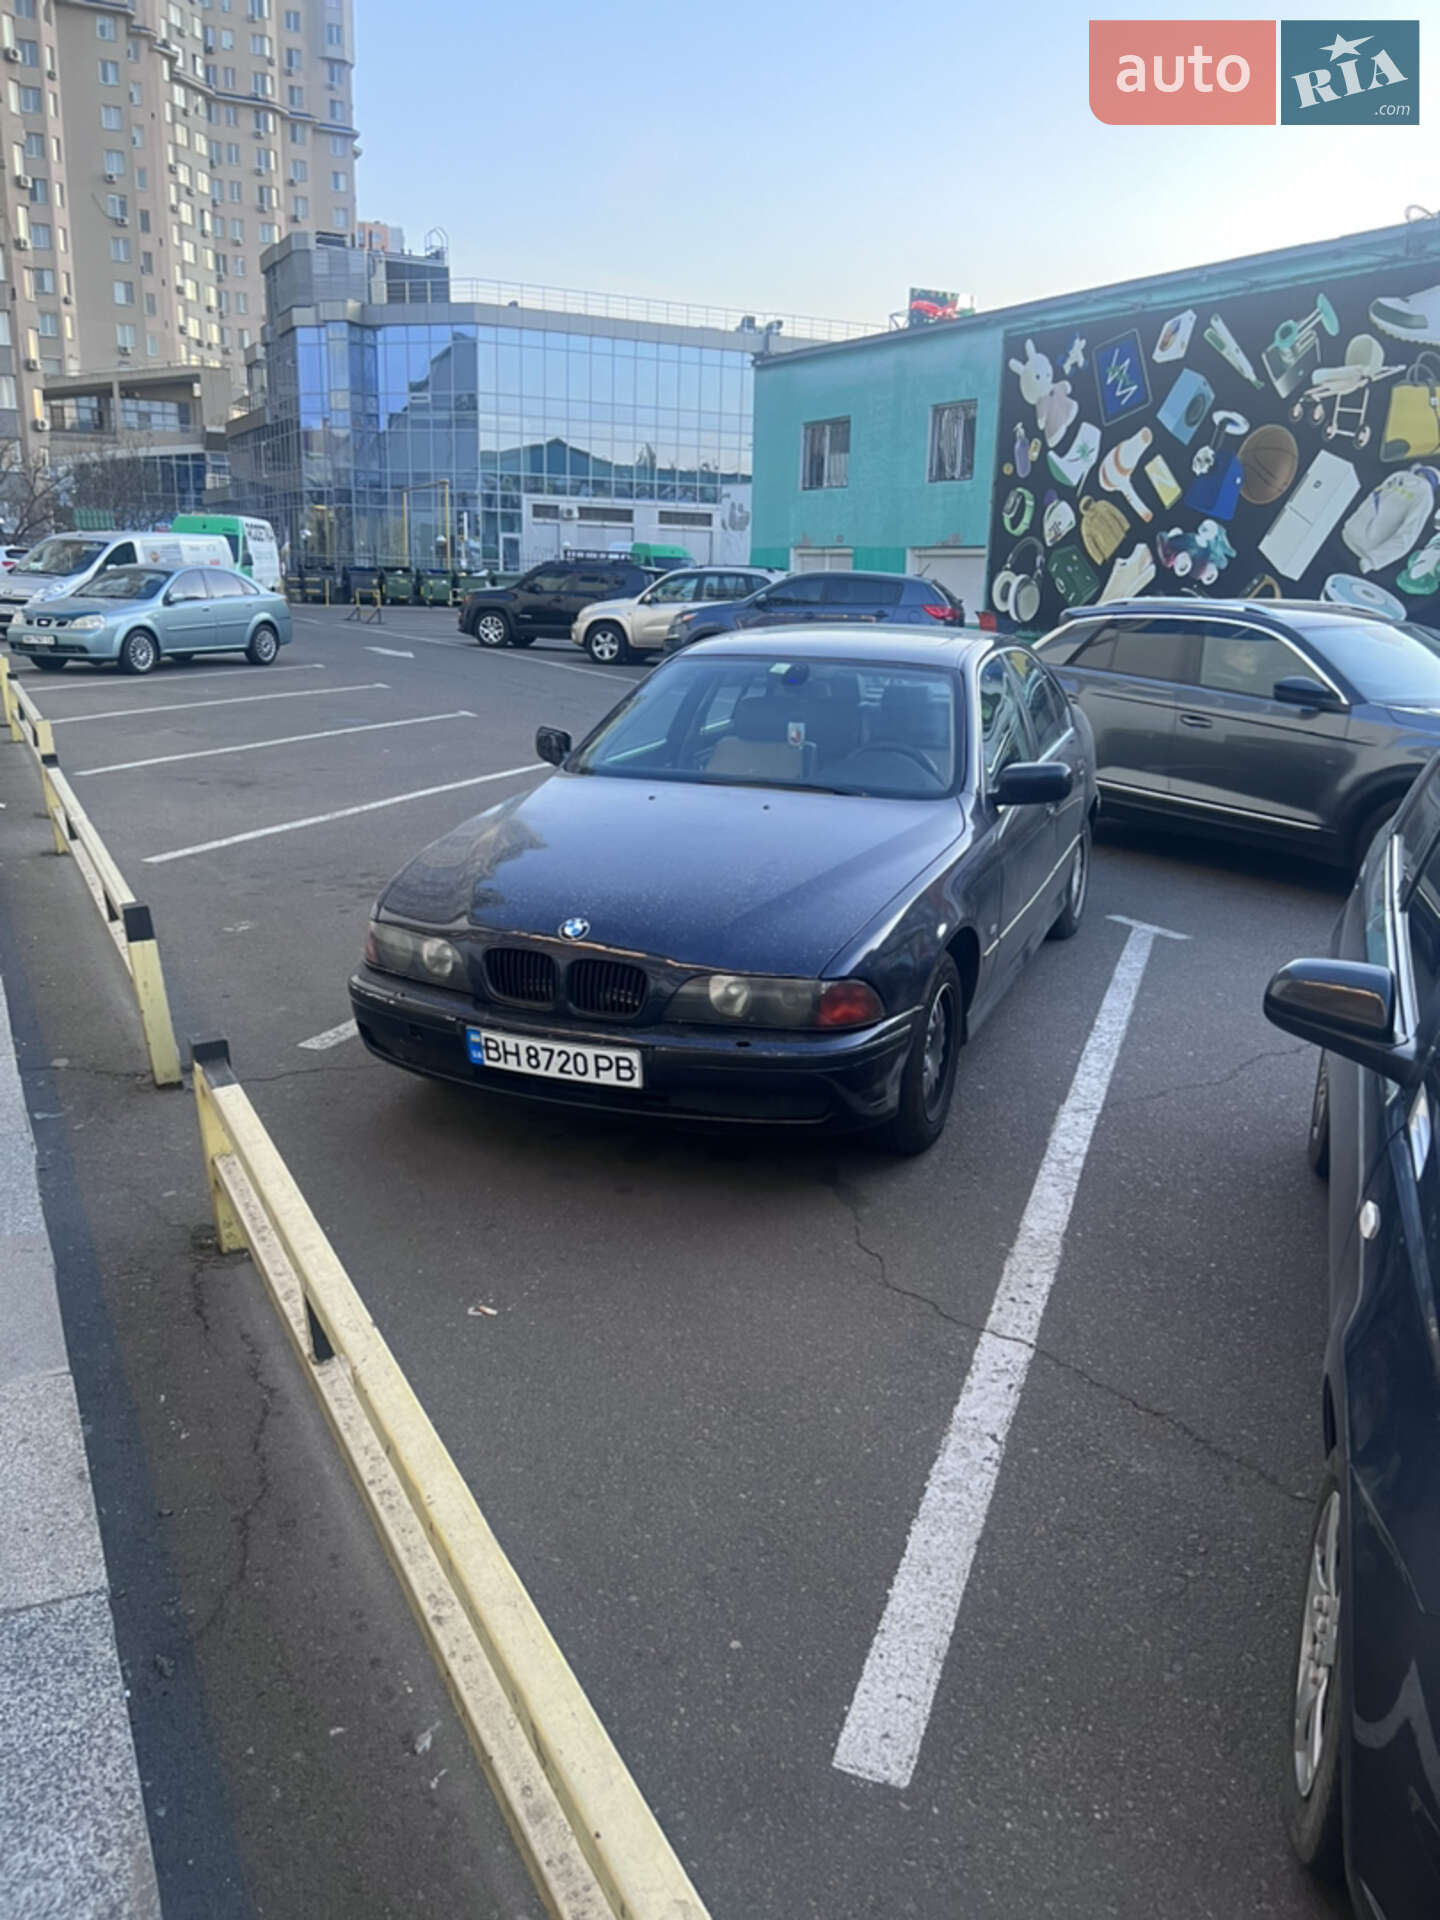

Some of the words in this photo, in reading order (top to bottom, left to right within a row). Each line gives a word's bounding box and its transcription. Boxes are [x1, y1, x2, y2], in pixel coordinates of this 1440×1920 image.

[484, 1037, 521, 1067] BH
[526, 1045, 588, 1077] 8720
[594, 1053, 635, 1081] PB
